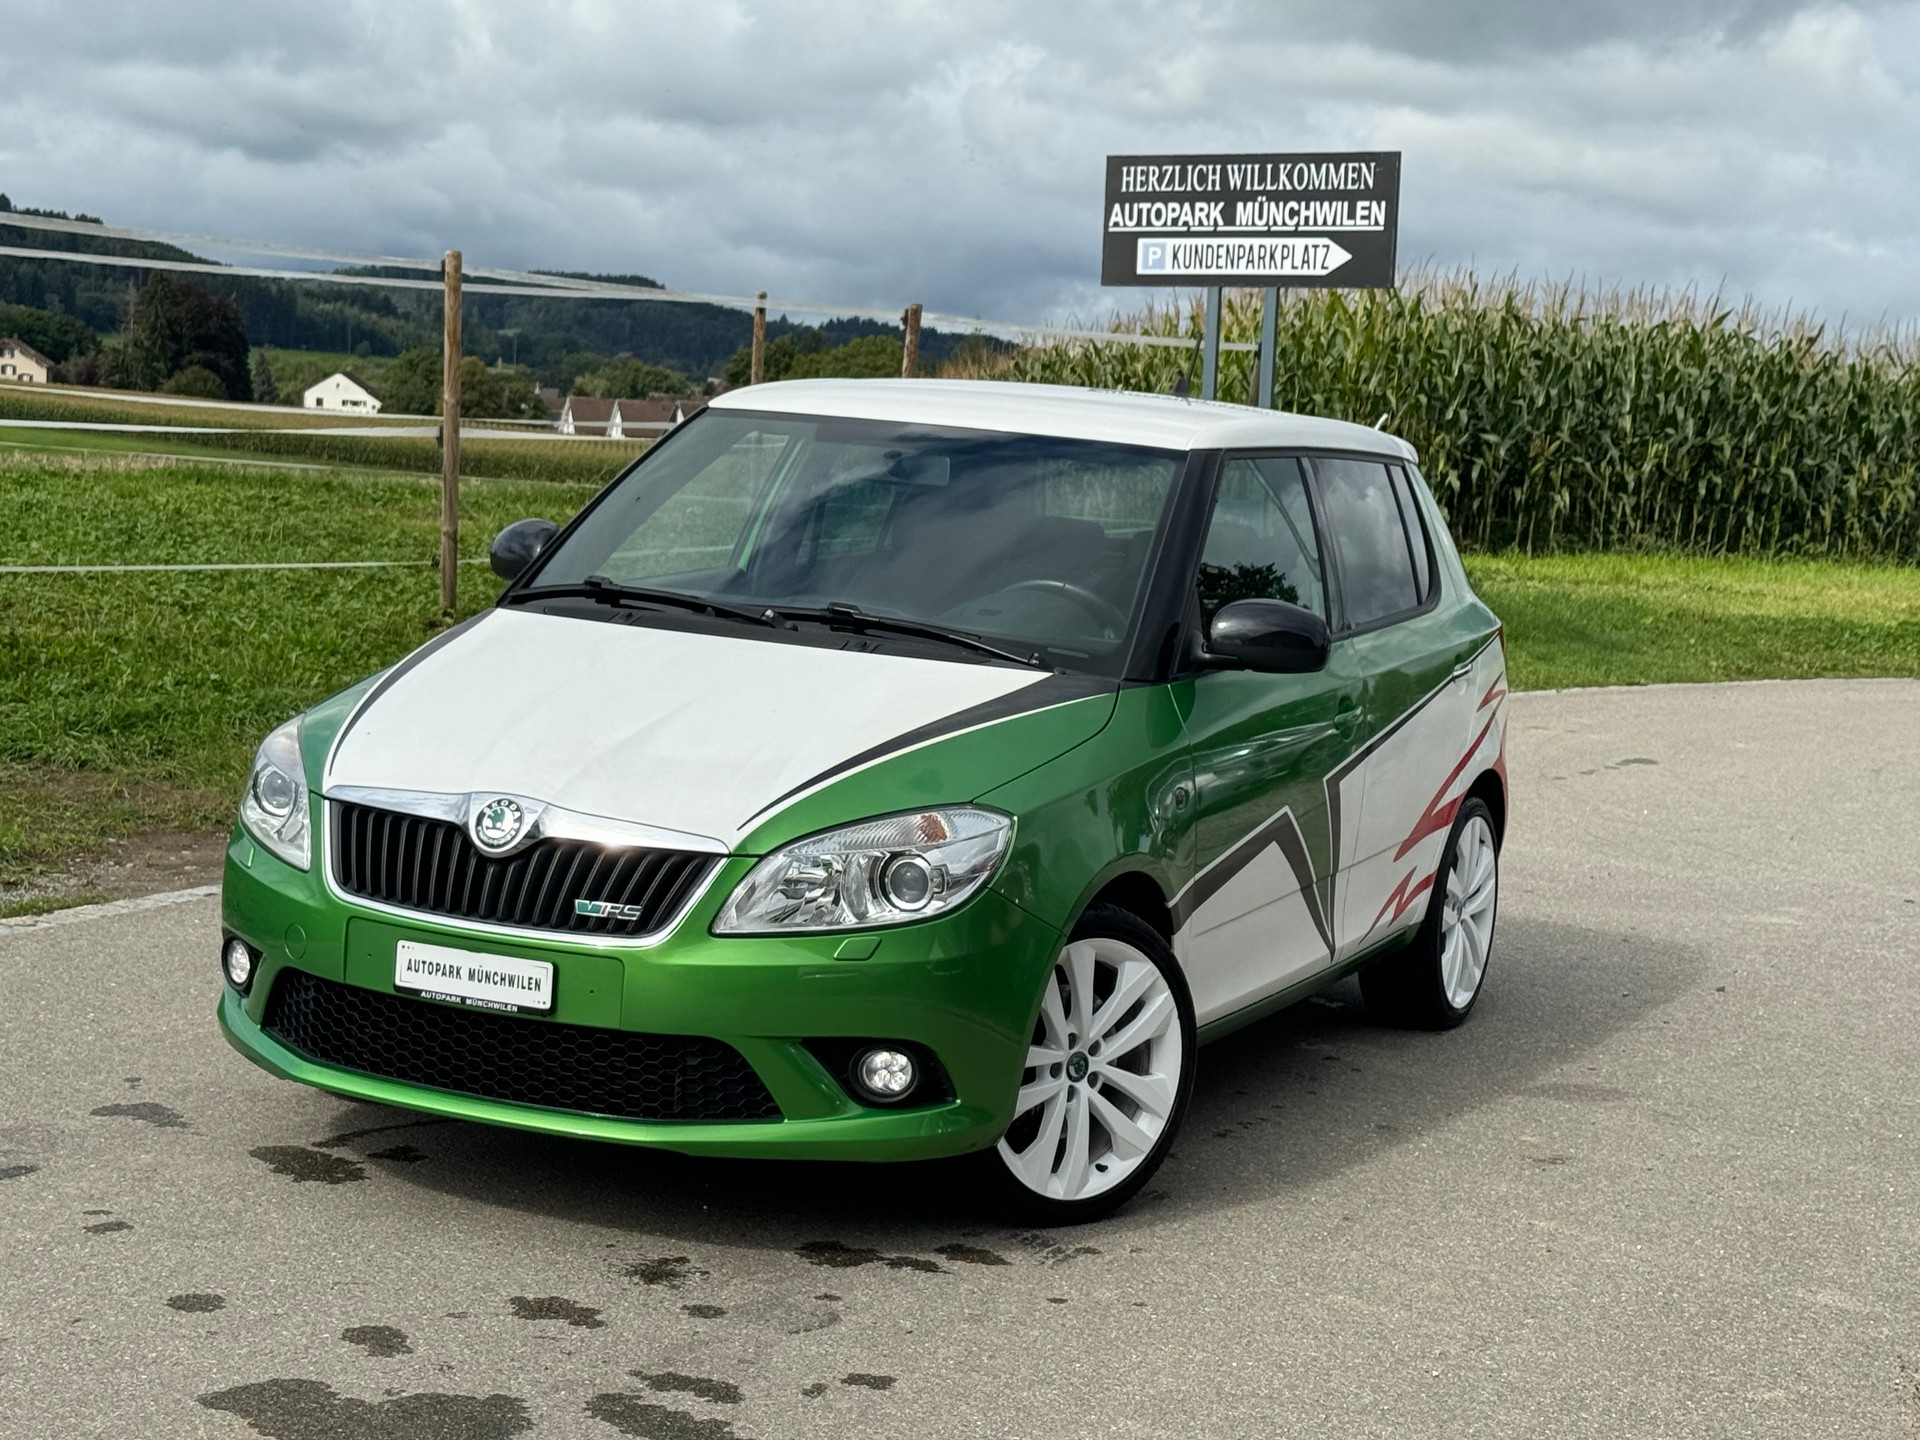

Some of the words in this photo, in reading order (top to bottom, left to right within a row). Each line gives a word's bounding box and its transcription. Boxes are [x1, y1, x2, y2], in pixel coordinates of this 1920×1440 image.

[1120, 164, 1222, 193] HERZLICH
[1226, 161, 1376, 191] WILLKOMMEN
[1108, 201, 1225, 227] AUTOPARK
[1235, 196, 1387, 227] MÜNCHWILEN
[1147, 246, 1162, 267] P
[1171, 243, 1331, 271] KUNDENPARKPLATZ
[406, 957, 463, 981] AUTOPARK
[467, 964, 542, 992] MÜNCHWILEN
[420, 990, 463, 1004] AUTOPARK
[465, 997, 518, 1013] MÜNCHWILEN
